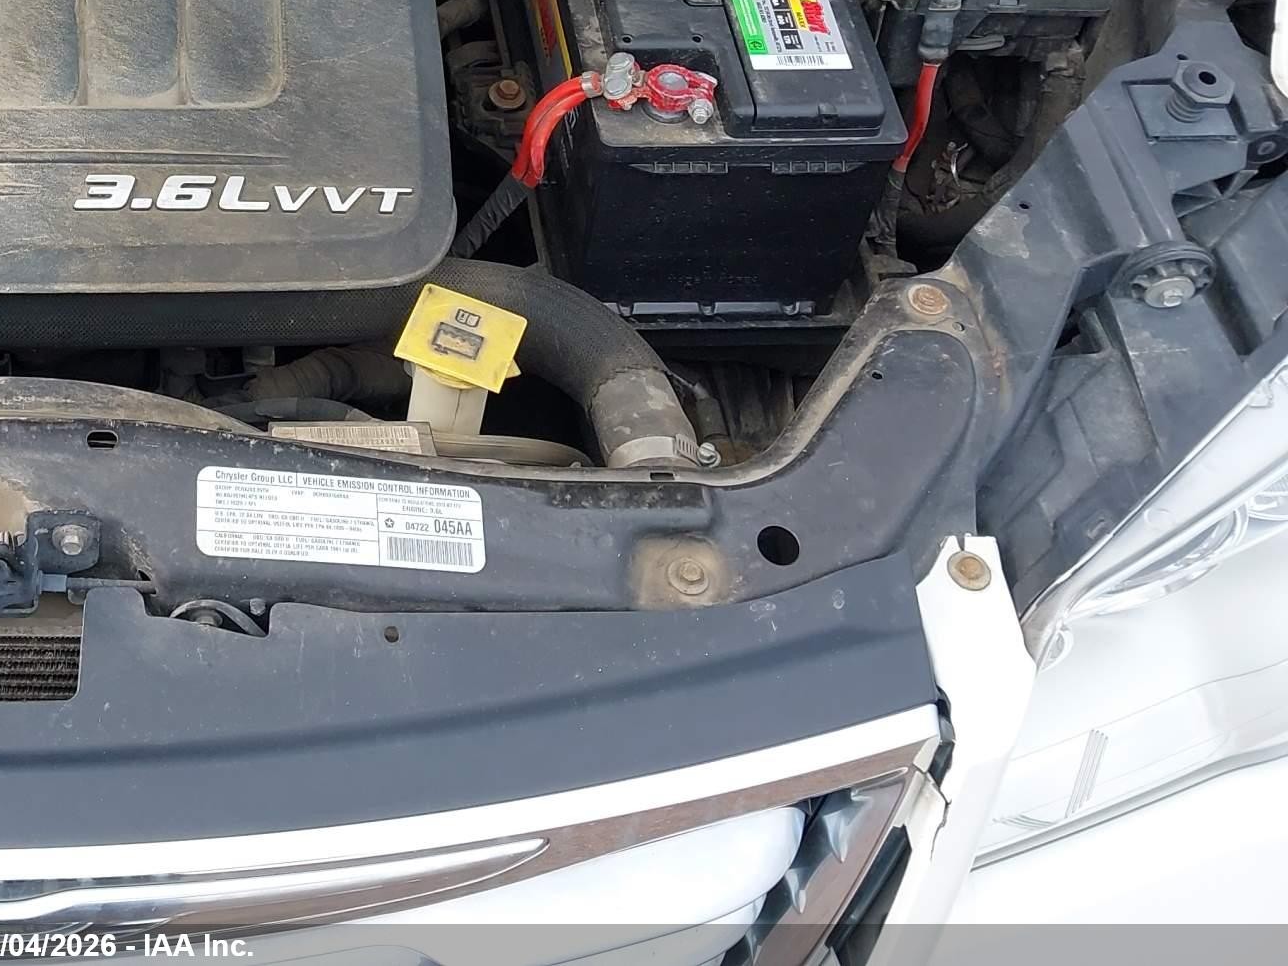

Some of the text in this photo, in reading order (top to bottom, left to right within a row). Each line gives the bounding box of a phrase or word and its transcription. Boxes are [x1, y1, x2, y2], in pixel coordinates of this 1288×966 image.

[215, 470, 293, 484] Chrysler Group LLC
[302, 476, 471, 499] VEHICLE EMISSION CONTROL INFORMATION
[433, 519, 473, 536] 045AA
